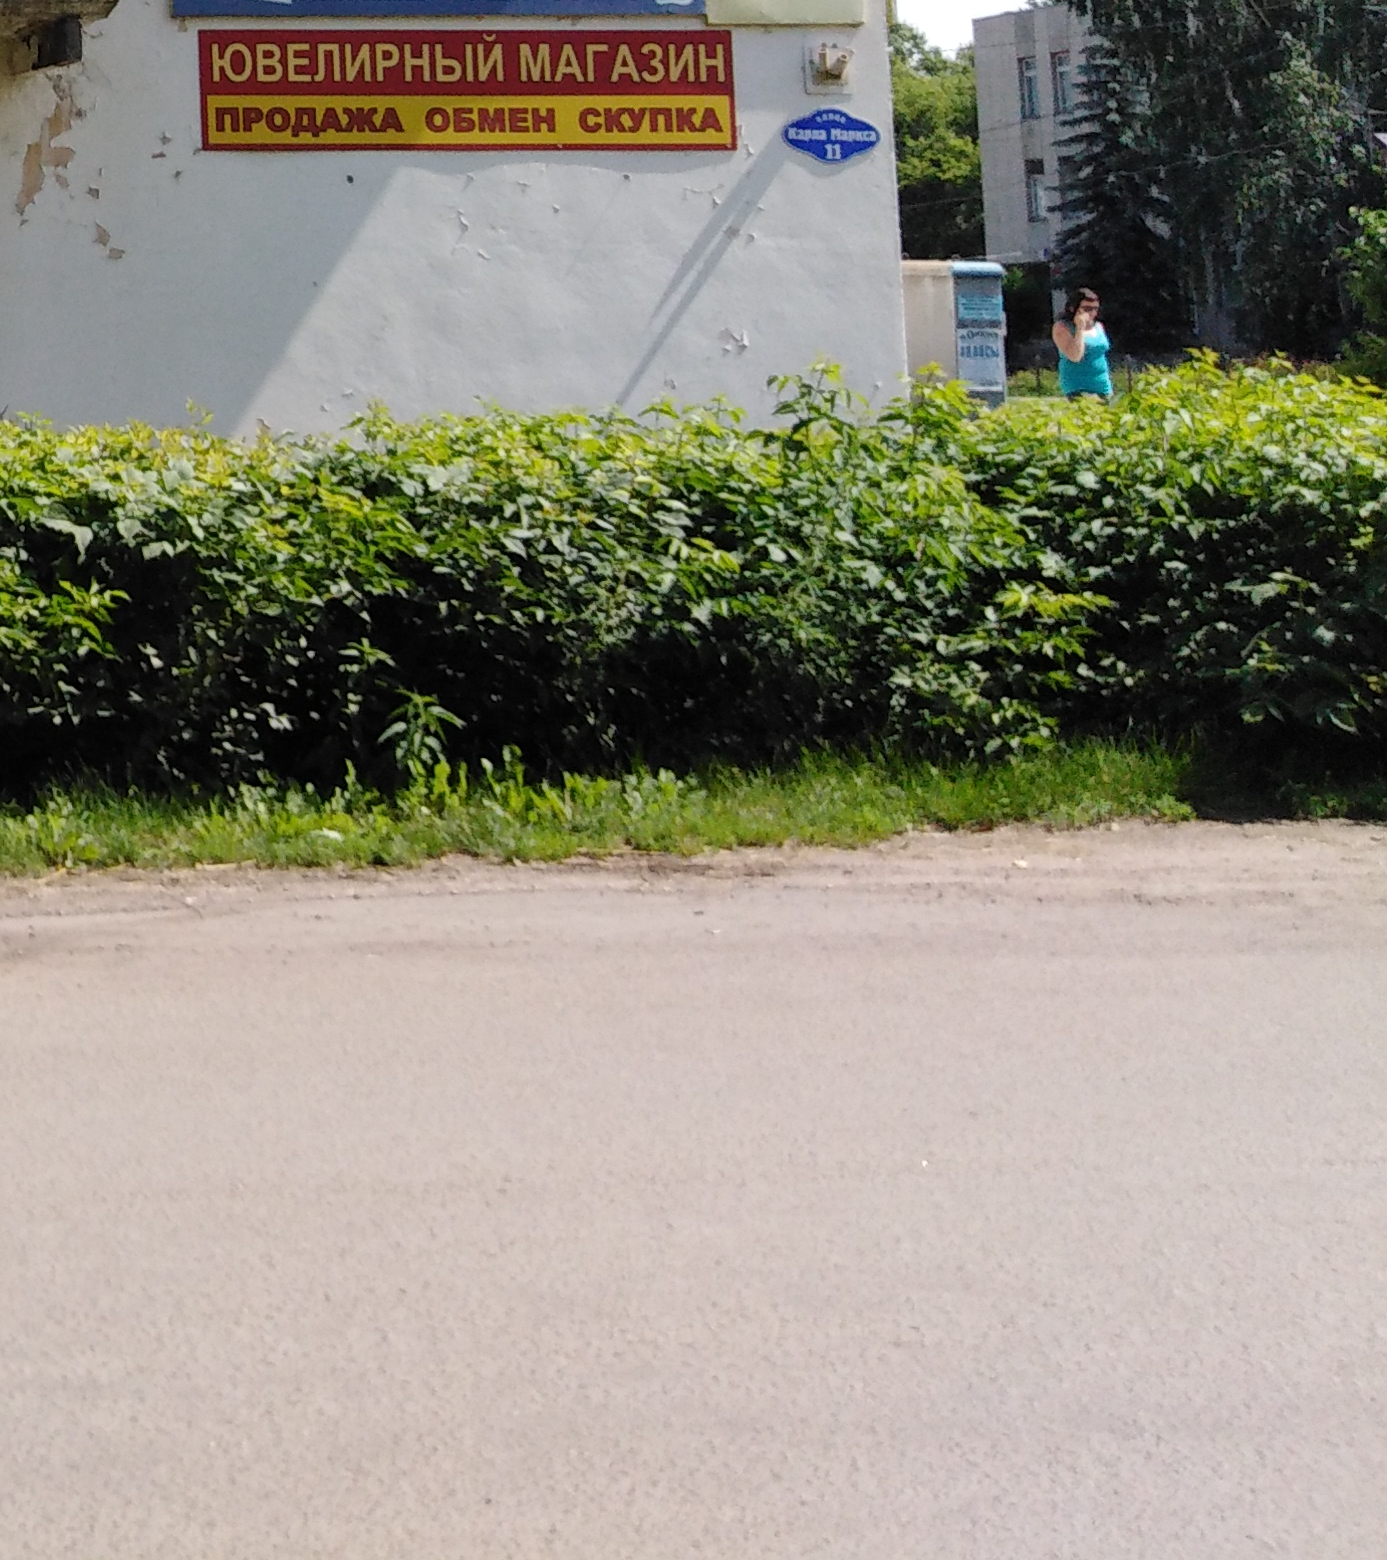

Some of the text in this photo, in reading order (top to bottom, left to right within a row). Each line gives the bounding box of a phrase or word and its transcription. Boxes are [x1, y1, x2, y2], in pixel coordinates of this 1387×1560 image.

[210, 33, 727, 83] ЮВЕЛИРНЫЙ МАГАЗИН
[214, 107, 724, 137] ПРОДАЖА ОБМЕН СКУПКА
[824, 143, 842, 160] 11
